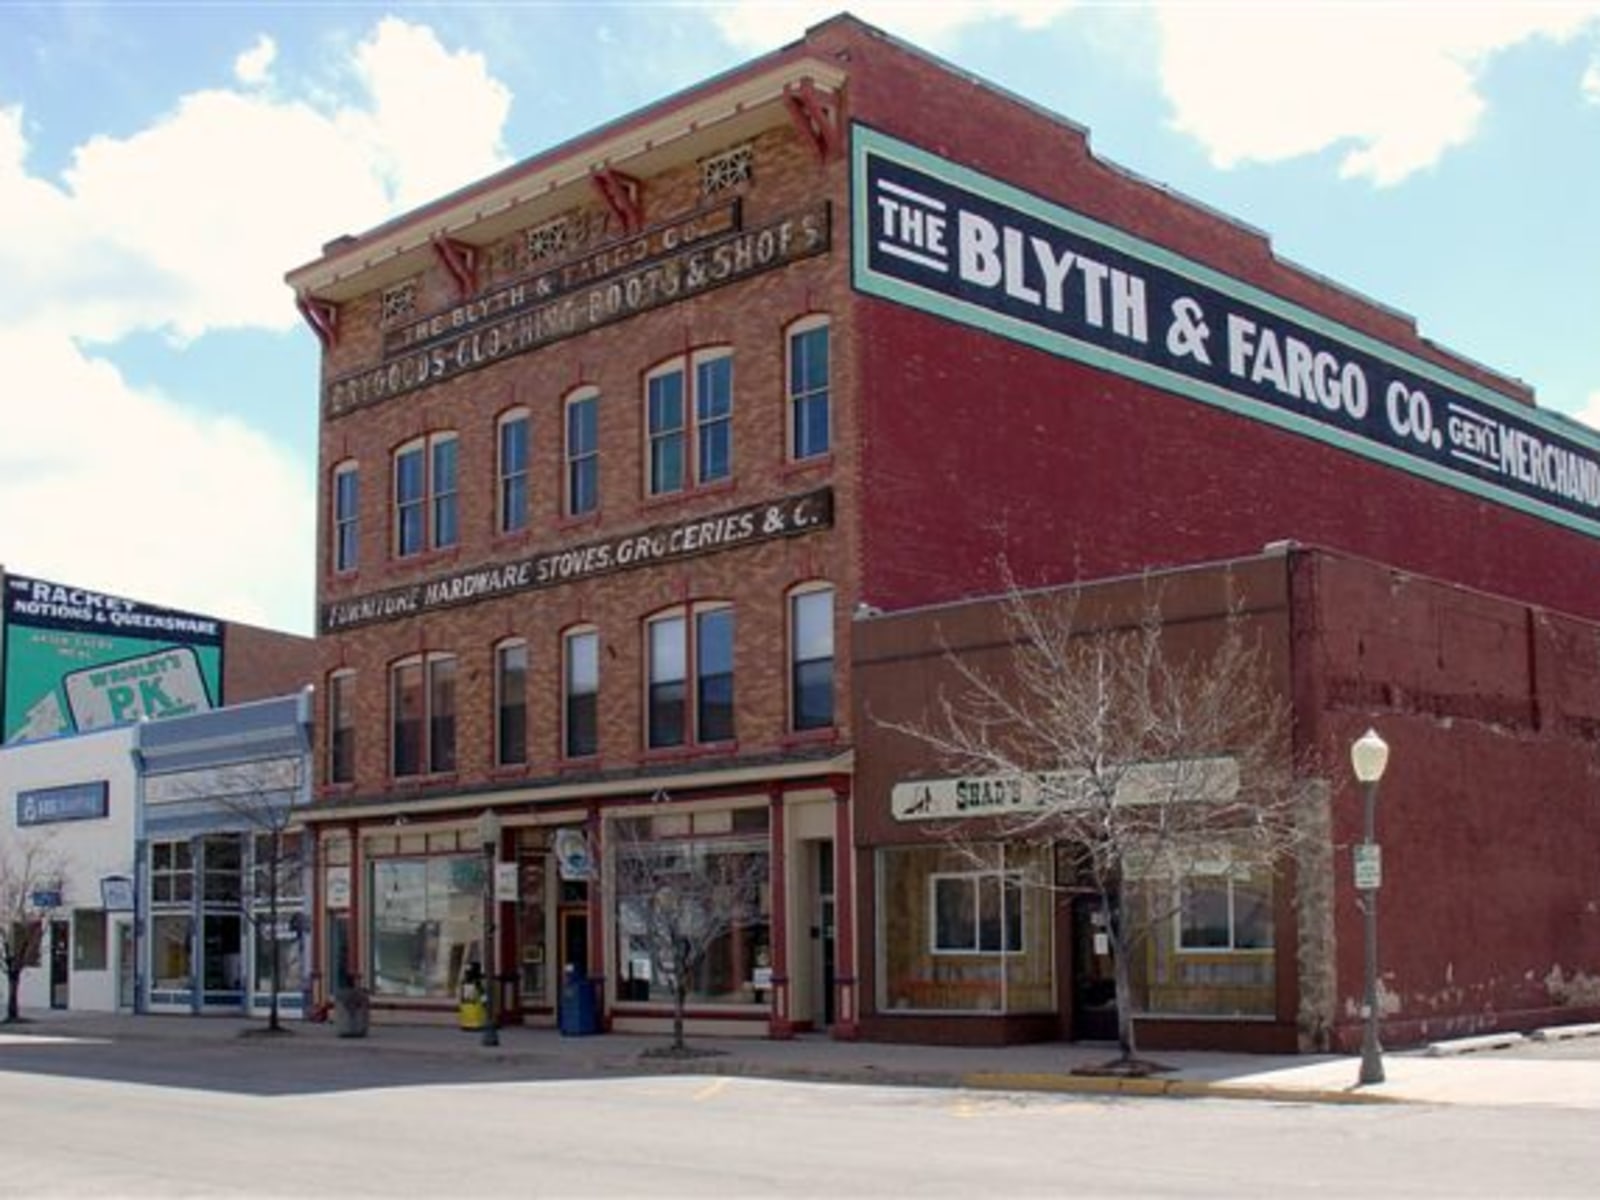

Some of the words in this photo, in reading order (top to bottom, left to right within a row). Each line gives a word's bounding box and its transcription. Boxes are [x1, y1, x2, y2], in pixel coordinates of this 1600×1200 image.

[403, 315, 444, 345] THE
[877, 196, 948, 256] THE
[958, 209, 1149, 344] BLYTH
[1166, 296, 1213, 366] &
[1227, 313, 1369, 420] FARGO
[1386, 381, 1443, 449] CO.
[424, 561, 531, 606] HARDWARE
[616, 512, 754, 564] GROCERIES
[762, 506, 785, 533] &
[14, 600, 94, 621] NOTIONS
